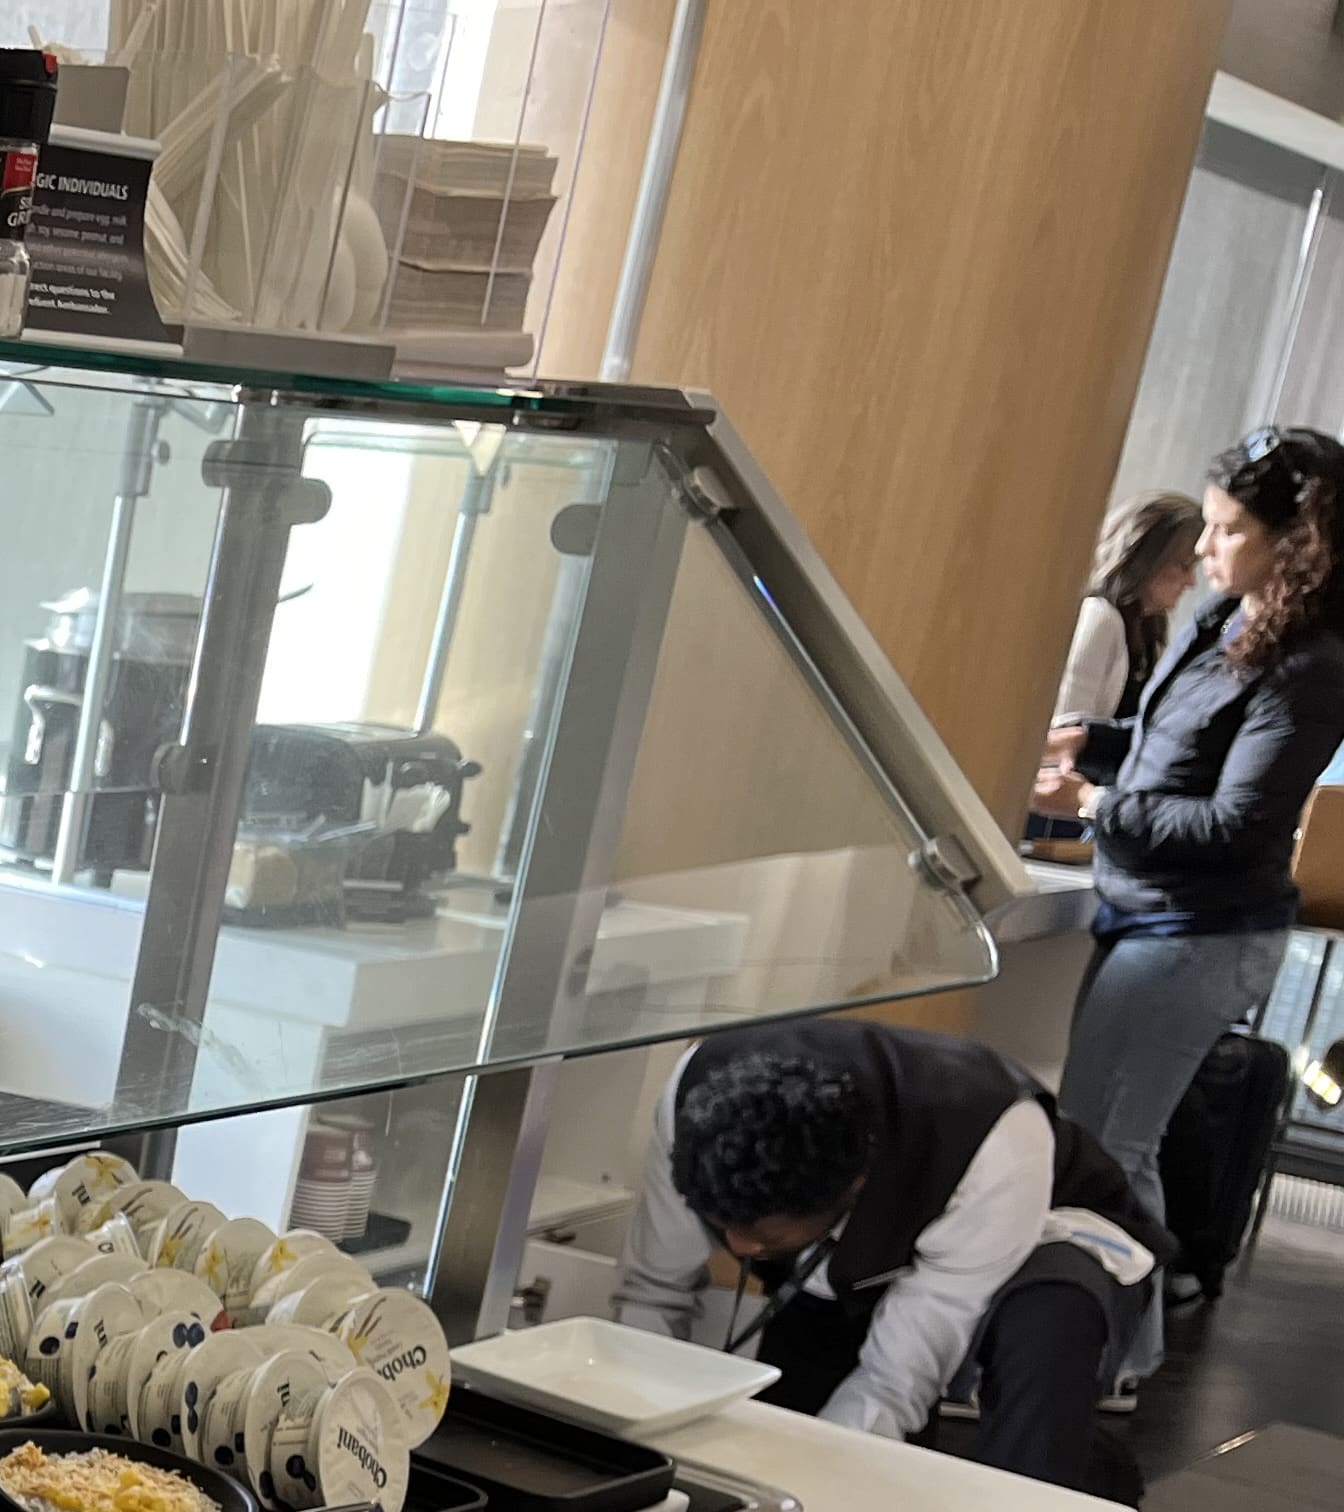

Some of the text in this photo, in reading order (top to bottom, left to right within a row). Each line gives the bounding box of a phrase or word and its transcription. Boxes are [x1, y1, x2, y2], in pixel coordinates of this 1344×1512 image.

[57, 175, 129, 201] INDIVIDUALS
[376, 1345, 428, 1382] Chob
[336, 1422, 388, 1490] Chobani
